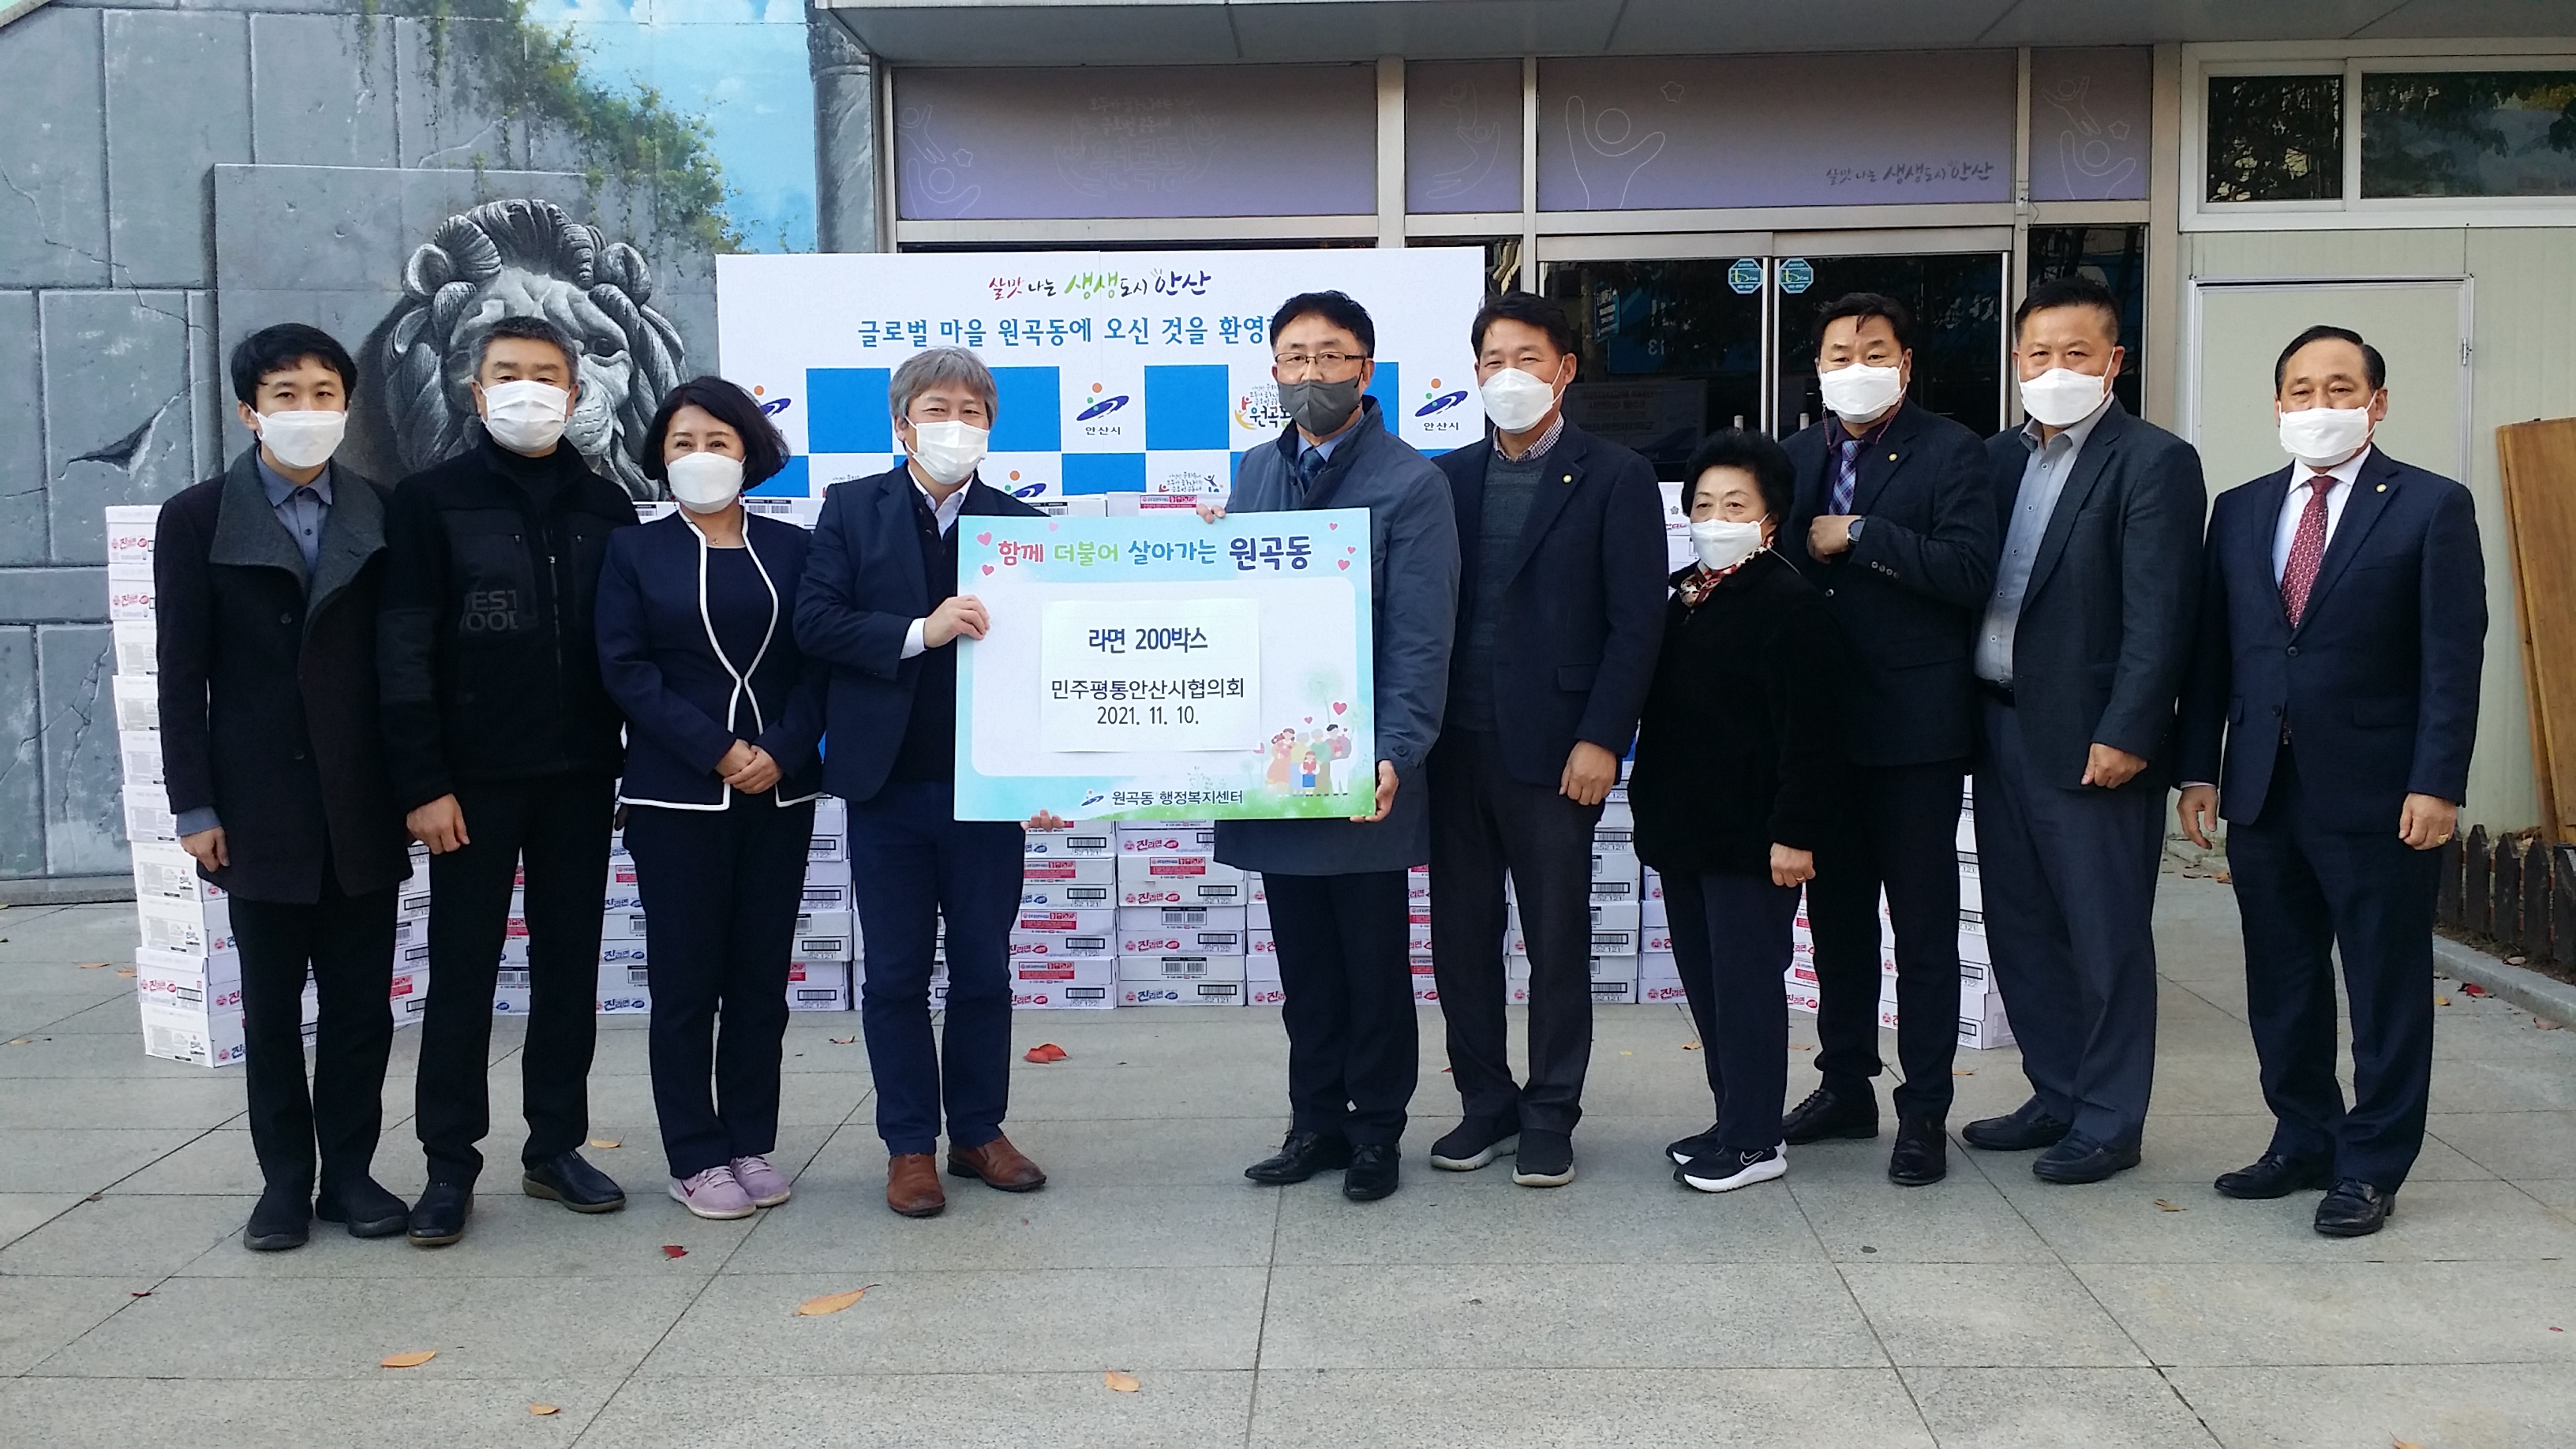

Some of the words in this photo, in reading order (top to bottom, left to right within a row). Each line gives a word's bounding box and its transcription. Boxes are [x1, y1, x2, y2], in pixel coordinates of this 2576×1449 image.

[1155, 270, 1211, 296] 안산
[858, 319, 927, 347] 글로벌
[940, 318, 987, 348] 마을
[998, 317, 1091, 346] 원곡동에
[1104, 317, 1150, 345] 오신
[1162, 316, 1208, 345] 것을
[1219, 314, 1274, 345] 환영
[1085, 426, 1121, 436] 안산시
[1424, 421, 1459, 431] 안산시
[998, 540, 1044, 566] 함께
[1054, 541, 1119, 567] 더불어
[1128, 539, 1217, 565] 살아가는
[1229, 535, 1312, 571] 원곡동
[1088, 627, 1126, 653] 라면
[1135, 627, 1208, 653] 200박스
[1051, 677, 1245, 701] 민주평통안산시협의회
[1097, 706, 1140, 725] 2021.
[1149, 706, 1168, 724] 11.
[1177, 706, 1199, 724] 10.
[1111, 791, 1155, 806] 원곡동
[1159, 790, 1244, 806] 행정복지센터
[1136, 839, 1163, 852] 진라면
[1138, 892, 1163, 904] 진라면
[1138, 939, 1163, 953] 진라면
[604, 949, 630, 961] 진라면
[1137, 990, 1163, 1003] 진라면
[604, 998, 630, 1011] 진라면
